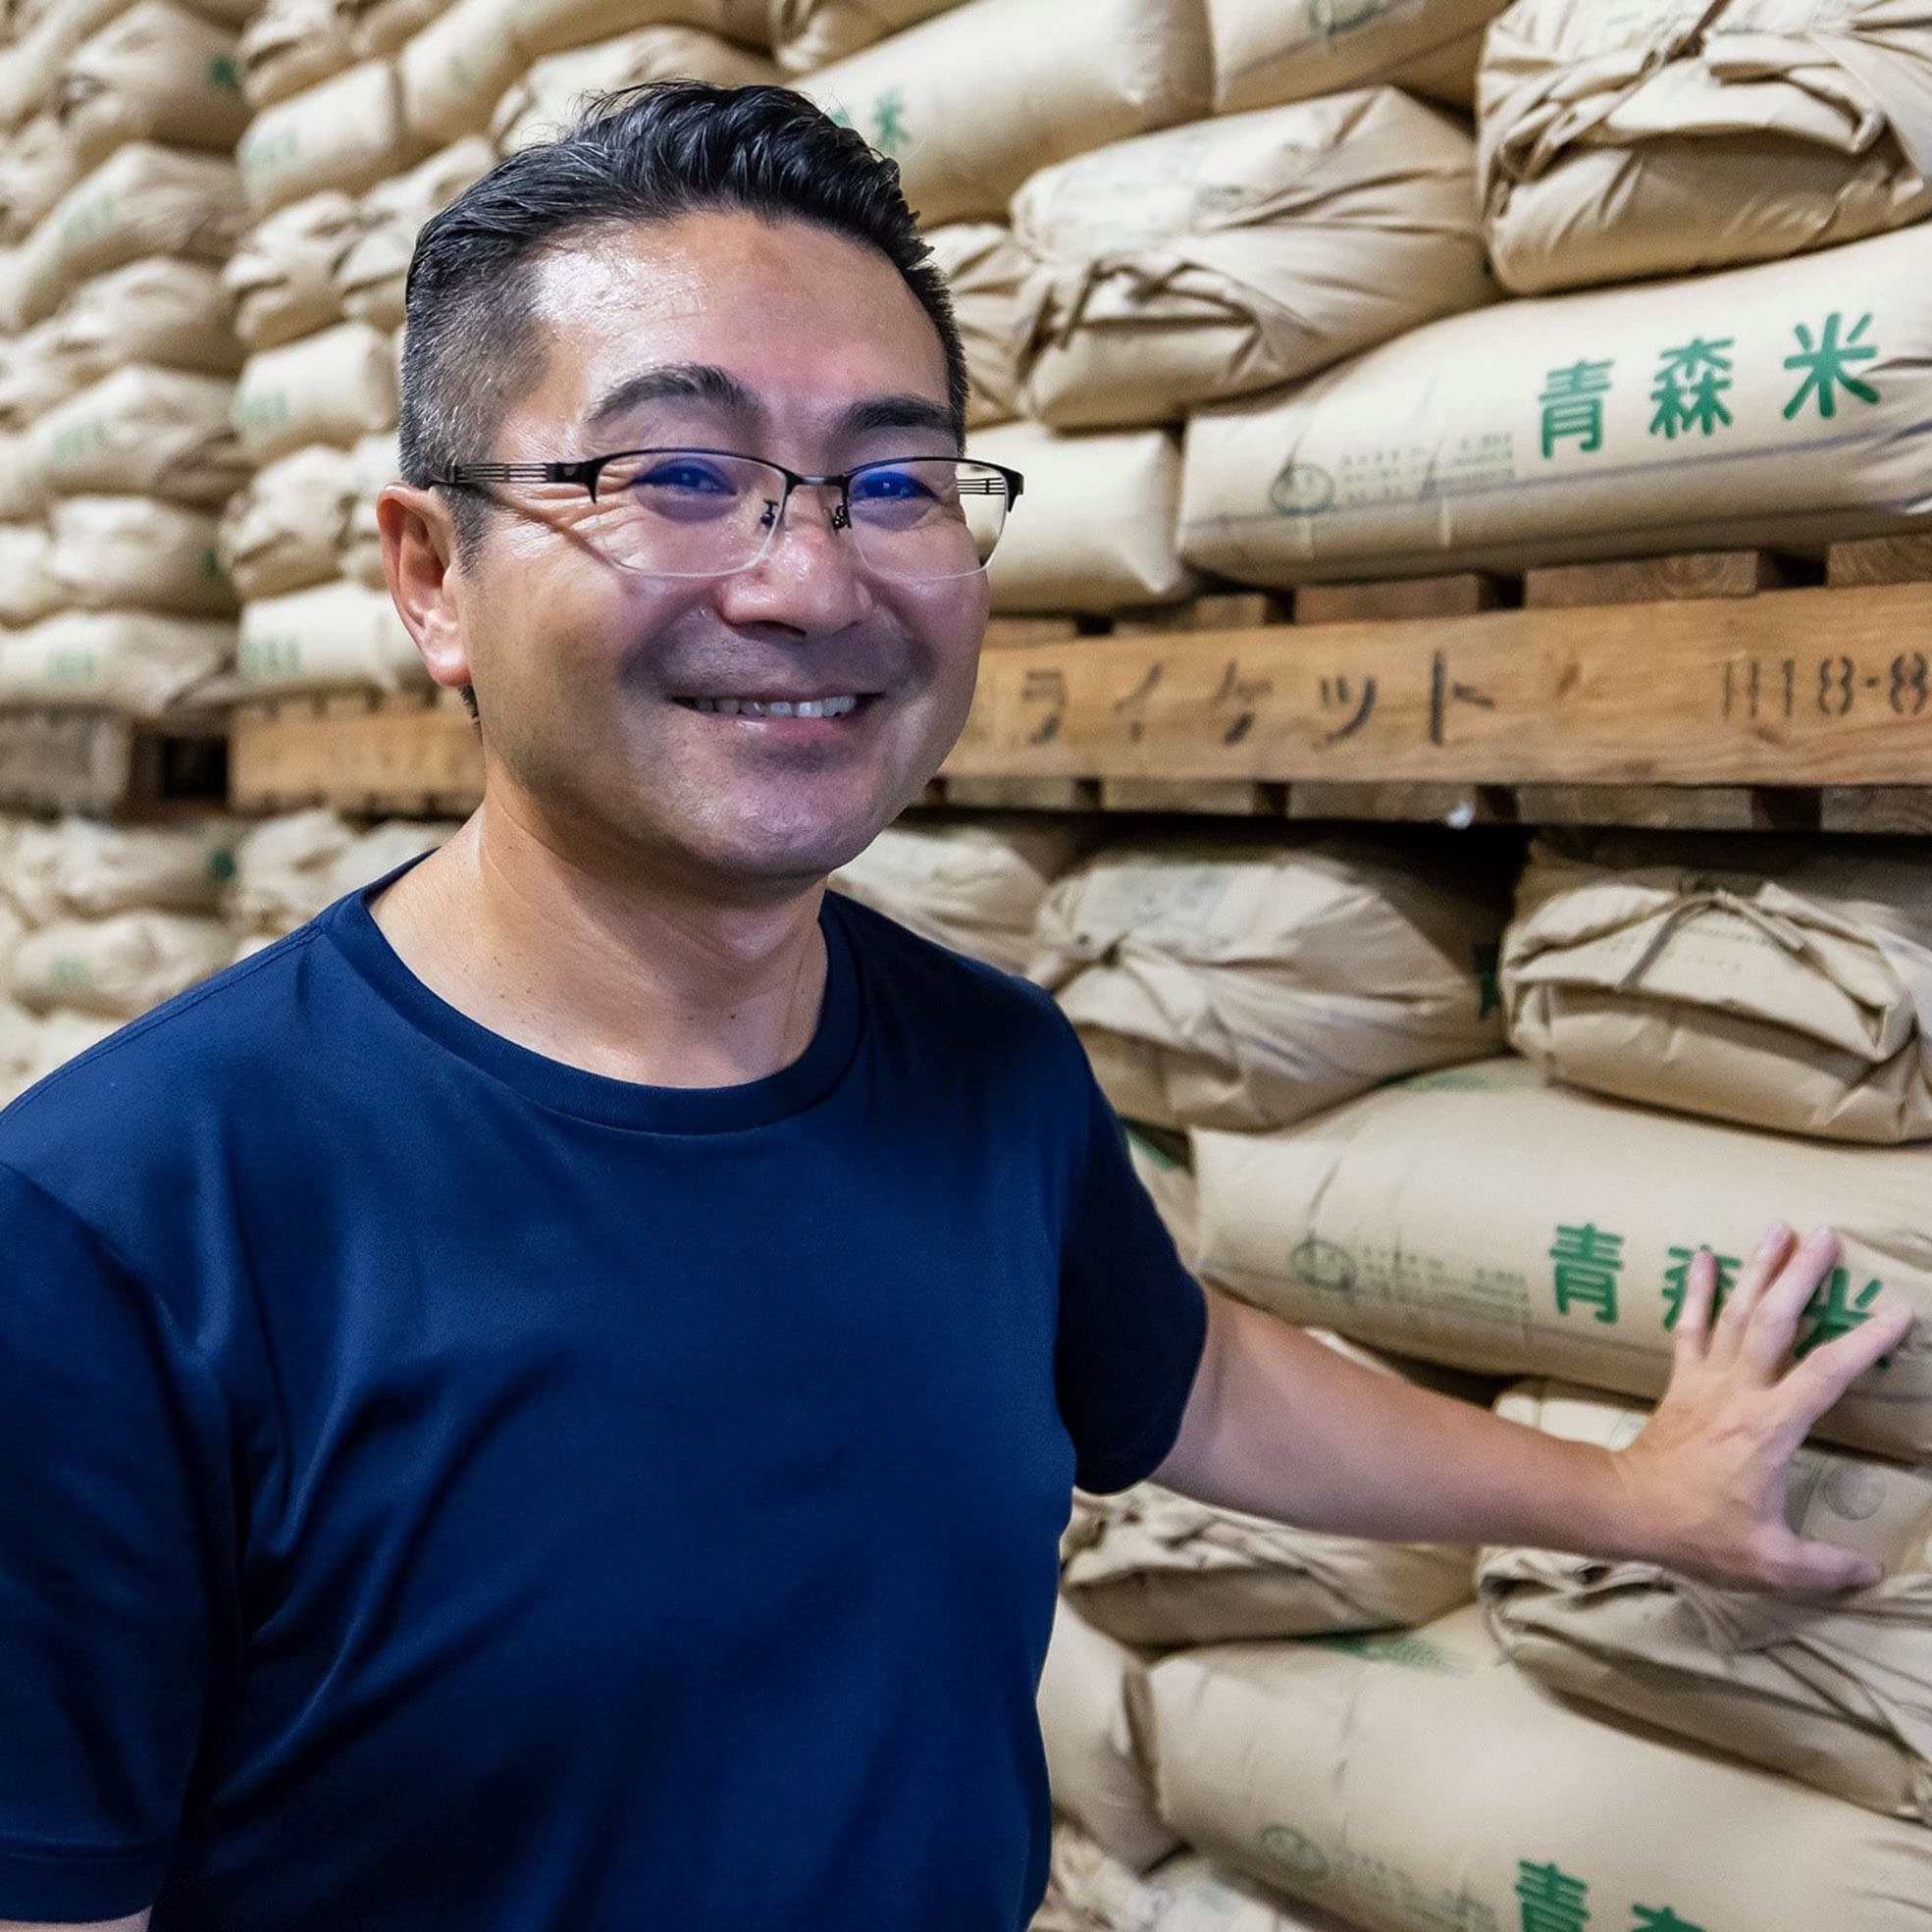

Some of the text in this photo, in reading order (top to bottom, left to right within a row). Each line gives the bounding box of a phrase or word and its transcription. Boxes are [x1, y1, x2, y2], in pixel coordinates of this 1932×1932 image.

[1539, 311, 1881, 459] 青森米
[1515, 1858, 1708, 1932] 青
